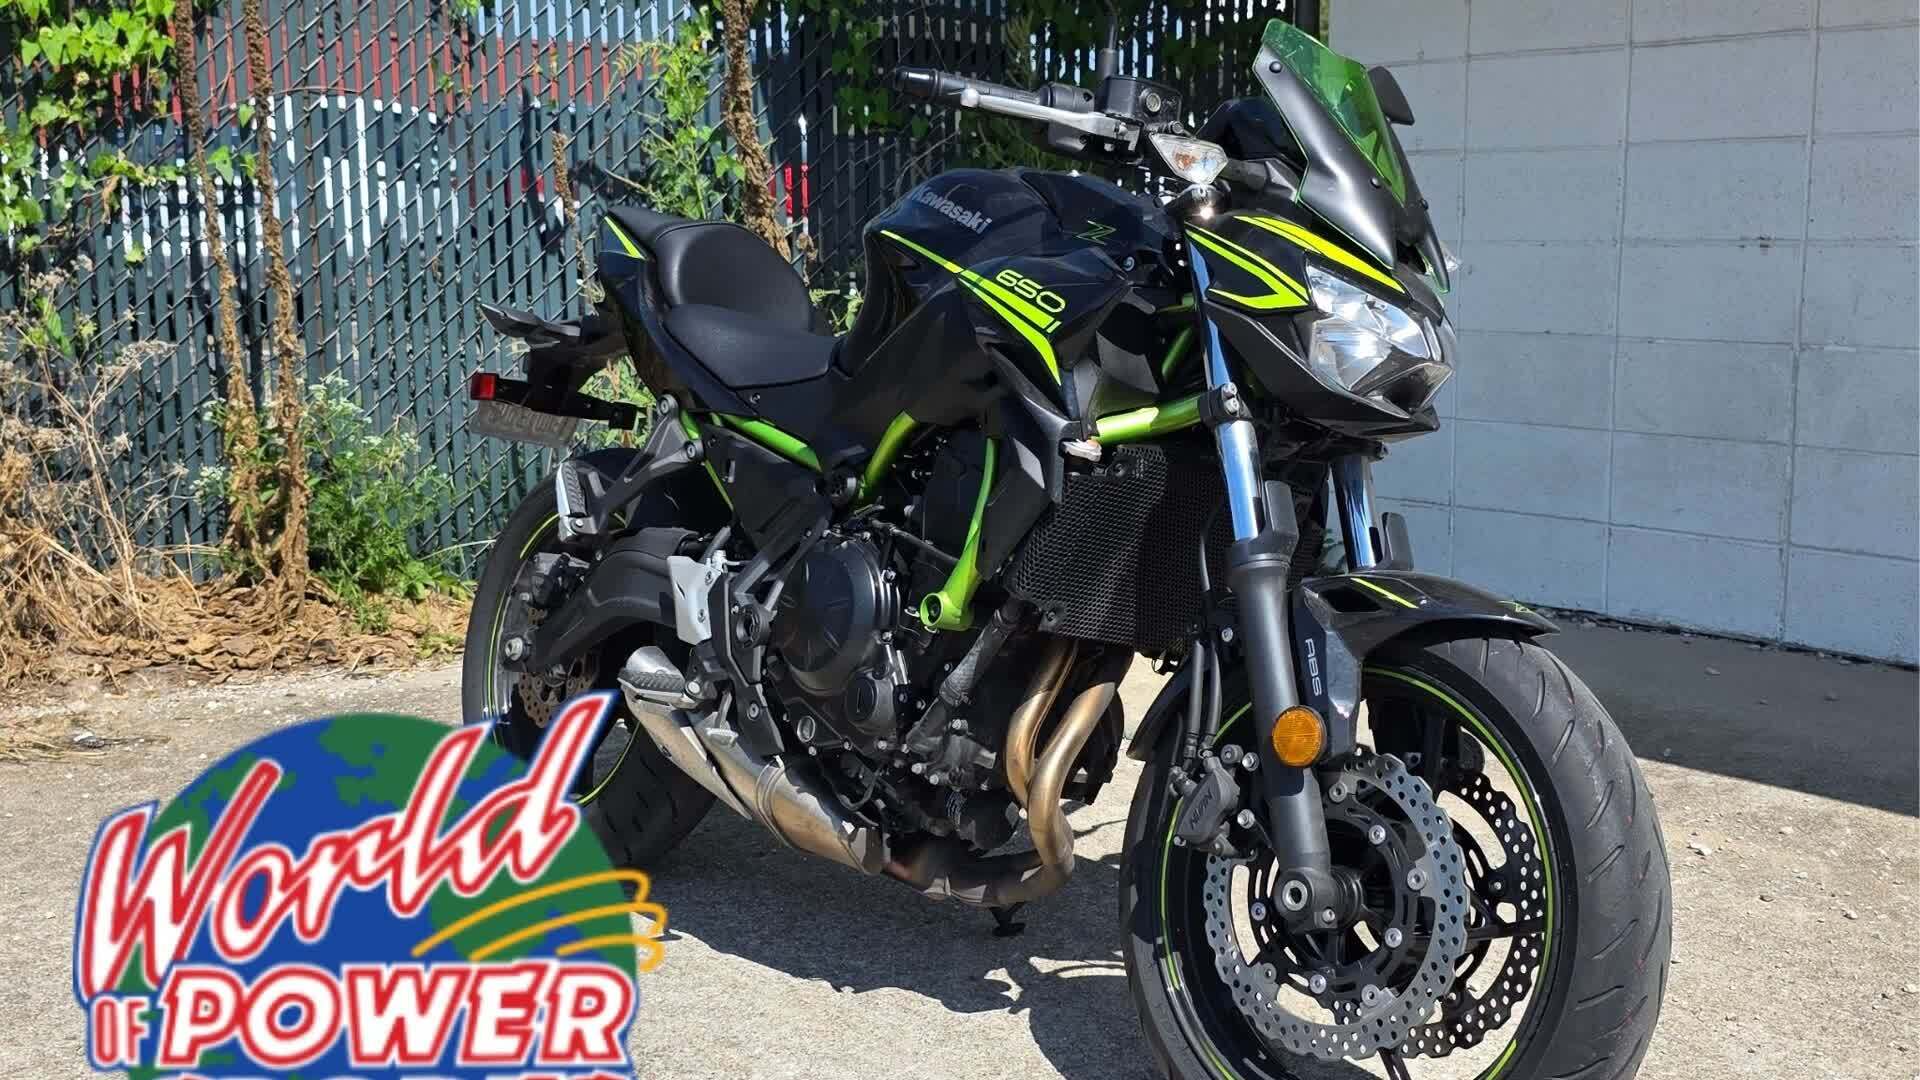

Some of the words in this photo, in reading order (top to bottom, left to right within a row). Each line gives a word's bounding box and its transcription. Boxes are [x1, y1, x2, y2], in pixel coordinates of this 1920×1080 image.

[911, 184, 993, 234] Kawasaki
[996, 269, 1066, 313] 650
[1305, 638, 1322, 697] ABS
